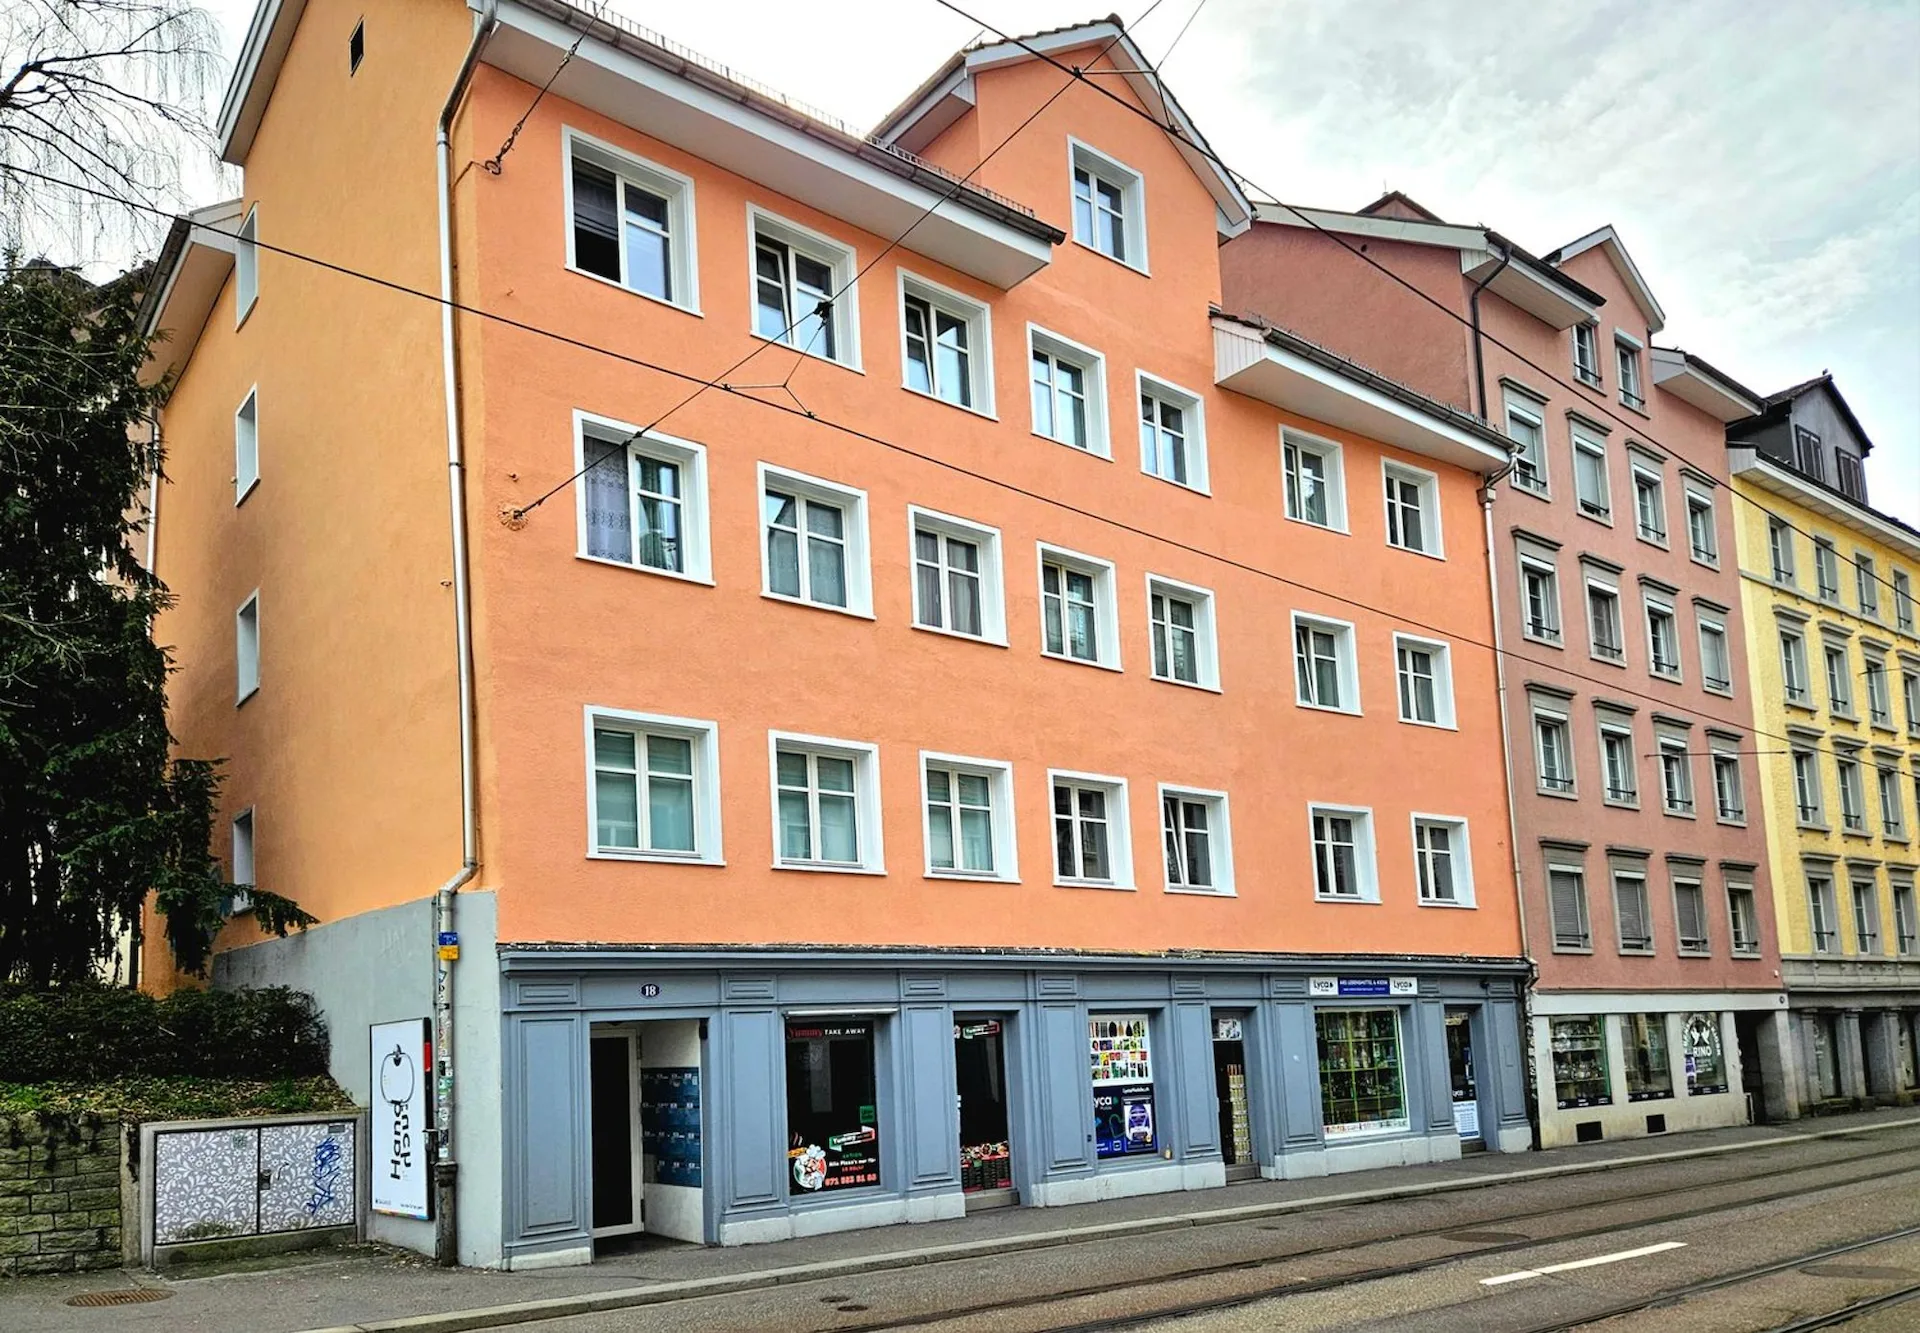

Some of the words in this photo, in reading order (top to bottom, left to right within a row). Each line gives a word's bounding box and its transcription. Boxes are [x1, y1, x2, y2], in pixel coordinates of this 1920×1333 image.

[1313, 980, 1329, 990] Lyca
[1394, 980, 1408, 989] Lyca
[645, 985, 657, 997] 18
[1693, 1046, 1712, 1058] RINO
[1094, 1096, 1112, 1108] yca
